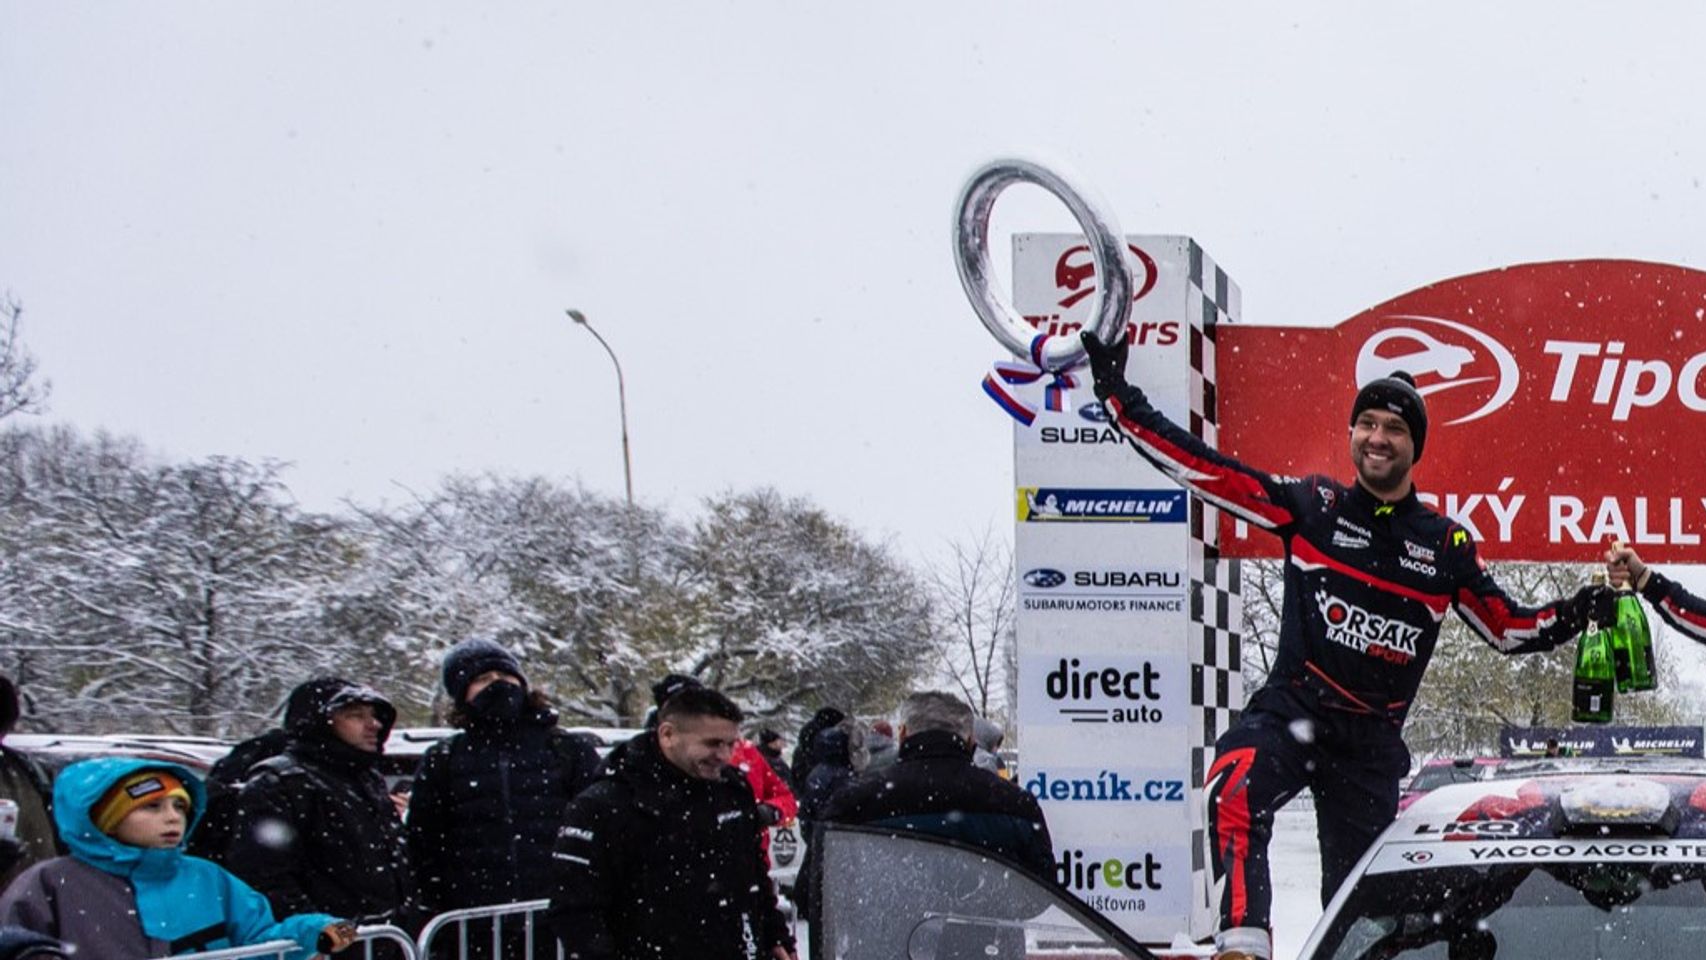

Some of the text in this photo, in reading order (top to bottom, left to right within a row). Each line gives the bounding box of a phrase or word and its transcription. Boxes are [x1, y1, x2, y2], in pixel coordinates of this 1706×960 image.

[1041, 427, 1129, 444] SUBA
[1066, 498, 1173, 515] MICHELIN
[1398, 555, 1437, 577] YACCO
[1074, 572, 1181, 588] SUBARU
[1024, 599, 1182, 612] SUBARU MOTORS FINANCE
[1322, 595, 1424, 656] ORSAK
[1046, 658, 1161, 700] direct
[1112, 706, 1163, 724] auto
[1633, 739, 1696, 749] MICHELIN
[1026, 771, 1185, 801] deník.cz
[1414, 820, 1519, 836] LKQ
[1471, 845, 1576, 859] YACCO
[1582, 845, 1669, 857] ACCR
[1055, 850, 1162, 890] direct
